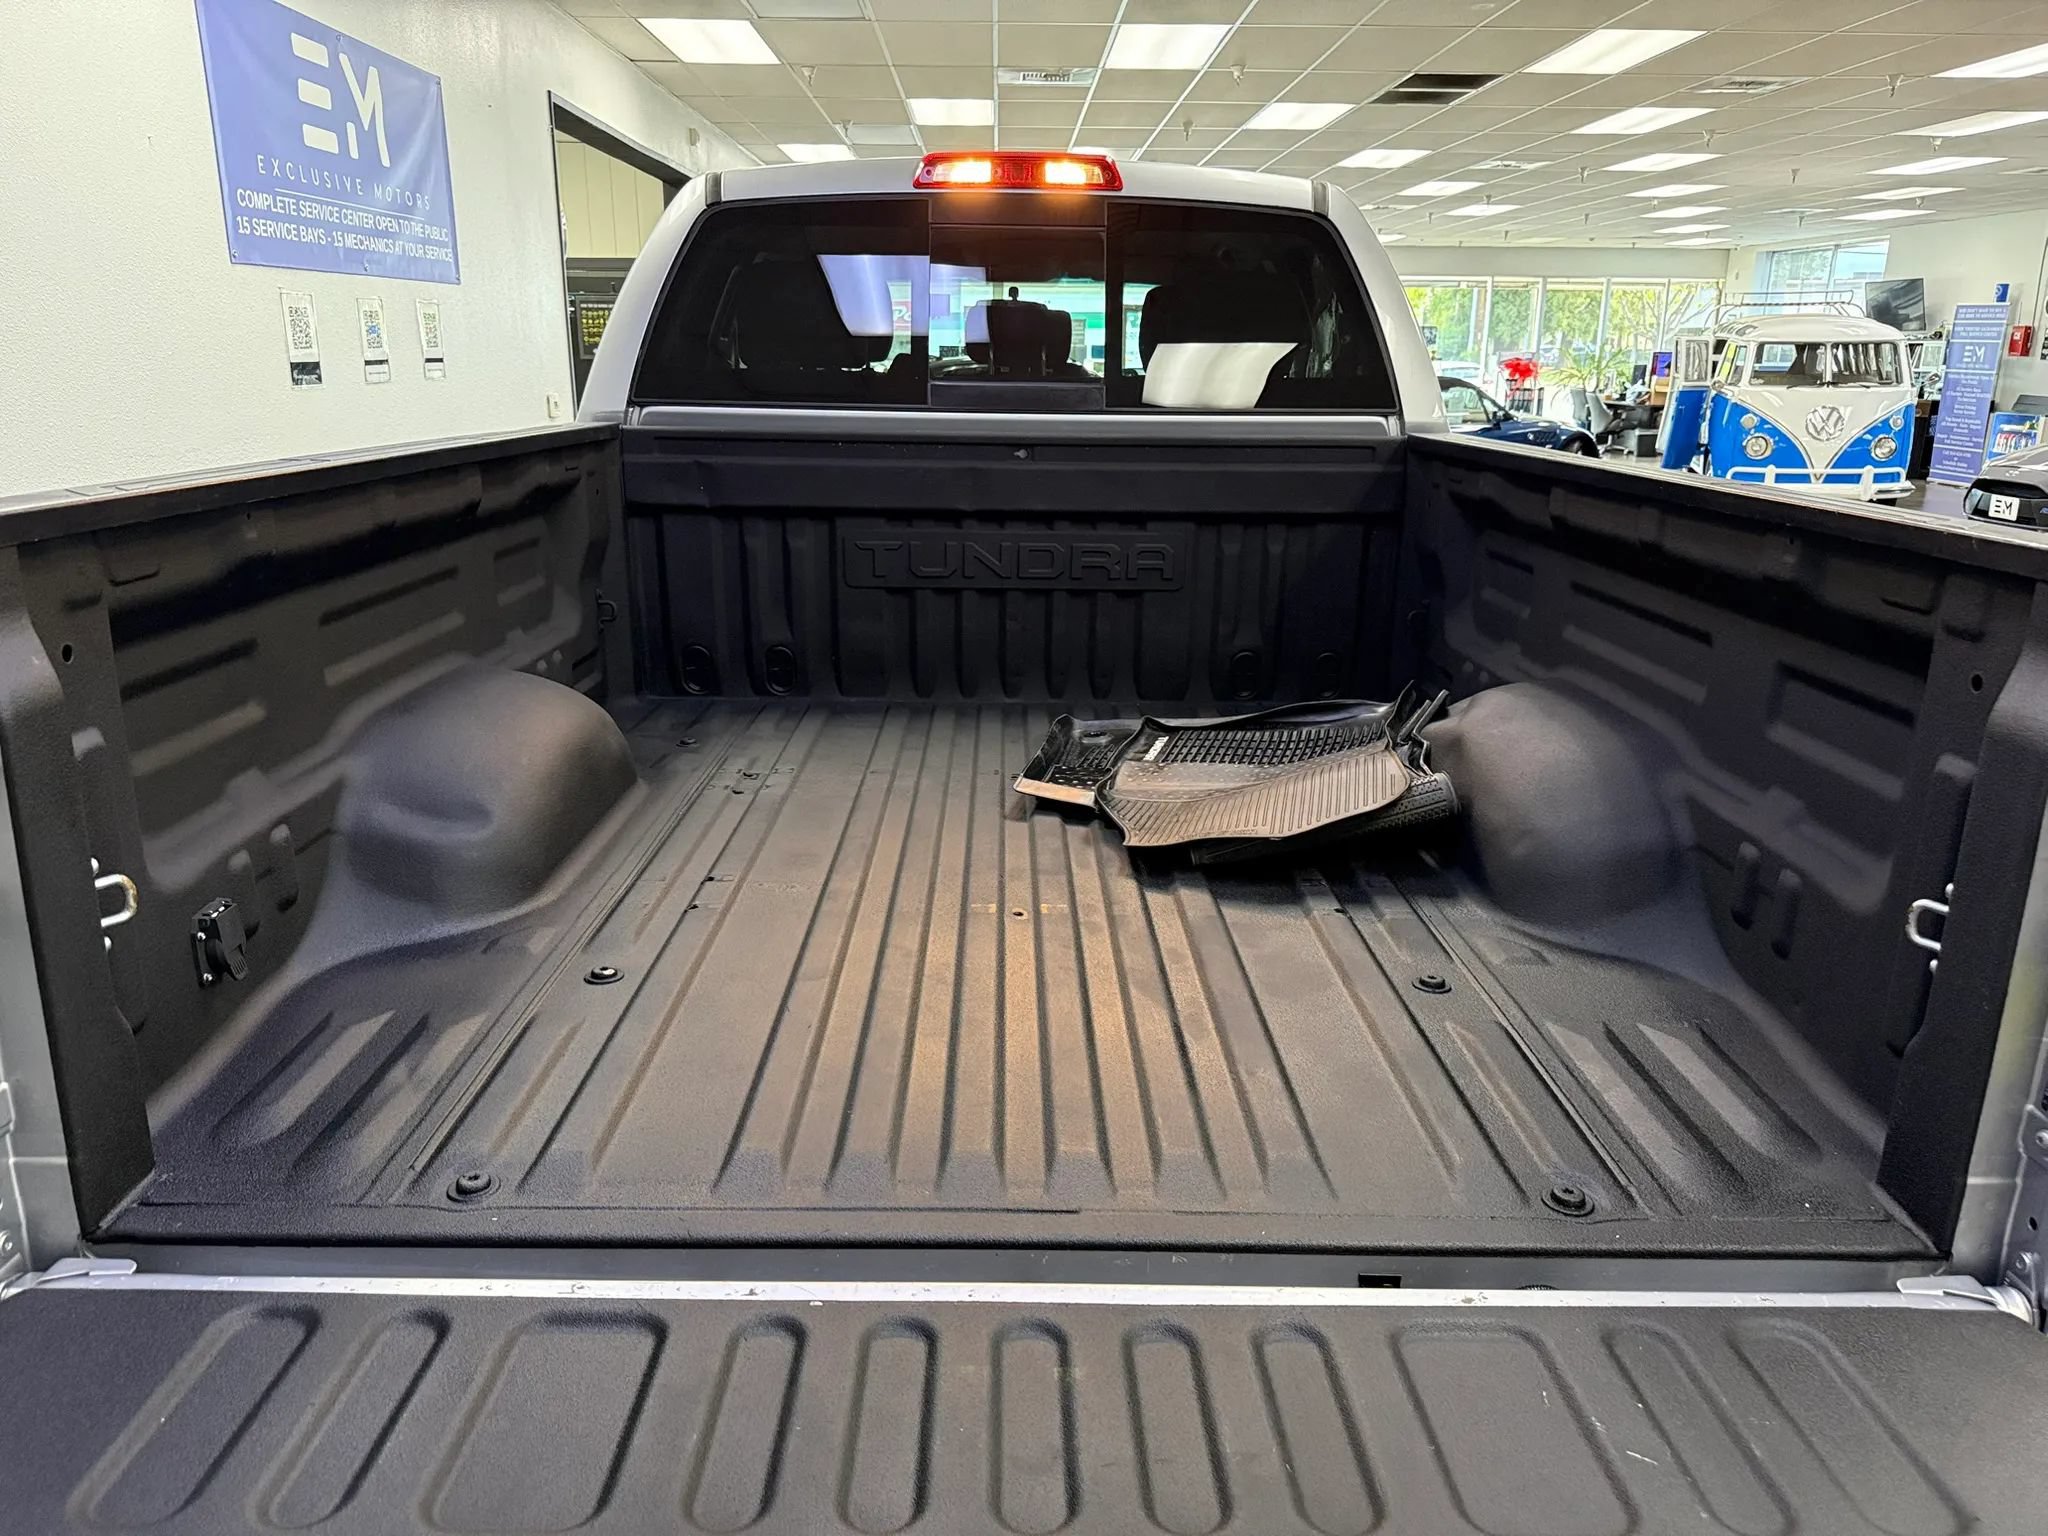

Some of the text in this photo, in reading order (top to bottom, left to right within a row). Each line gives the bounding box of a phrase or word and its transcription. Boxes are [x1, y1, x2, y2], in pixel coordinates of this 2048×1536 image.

[290, 32, 391, 168] EM
[256, 153, 431, 211] EXCLUSIVE MOTORS
[236, 188, 449, 242] COMPLETE SERVICE CENTER OPEN TO THE PUBLIC
[236, 216, 251, 235] 15
[252, 217, 299, 242] SERVICE
[299, 225, 326, 245] BAYS
[332, 231, 344, 247] 15
[344, 233, 394, 254] MECHANICS
[394, 240, 404, 256] AT
[402, 241, 425, 259] YOUR
[425, 245, 454, 262] SERVICE
[1963, 345, 1985, 363] EM
[1994, 499, 2013, 516] EM
[854, 541, 1175, 581] TUNDRA
